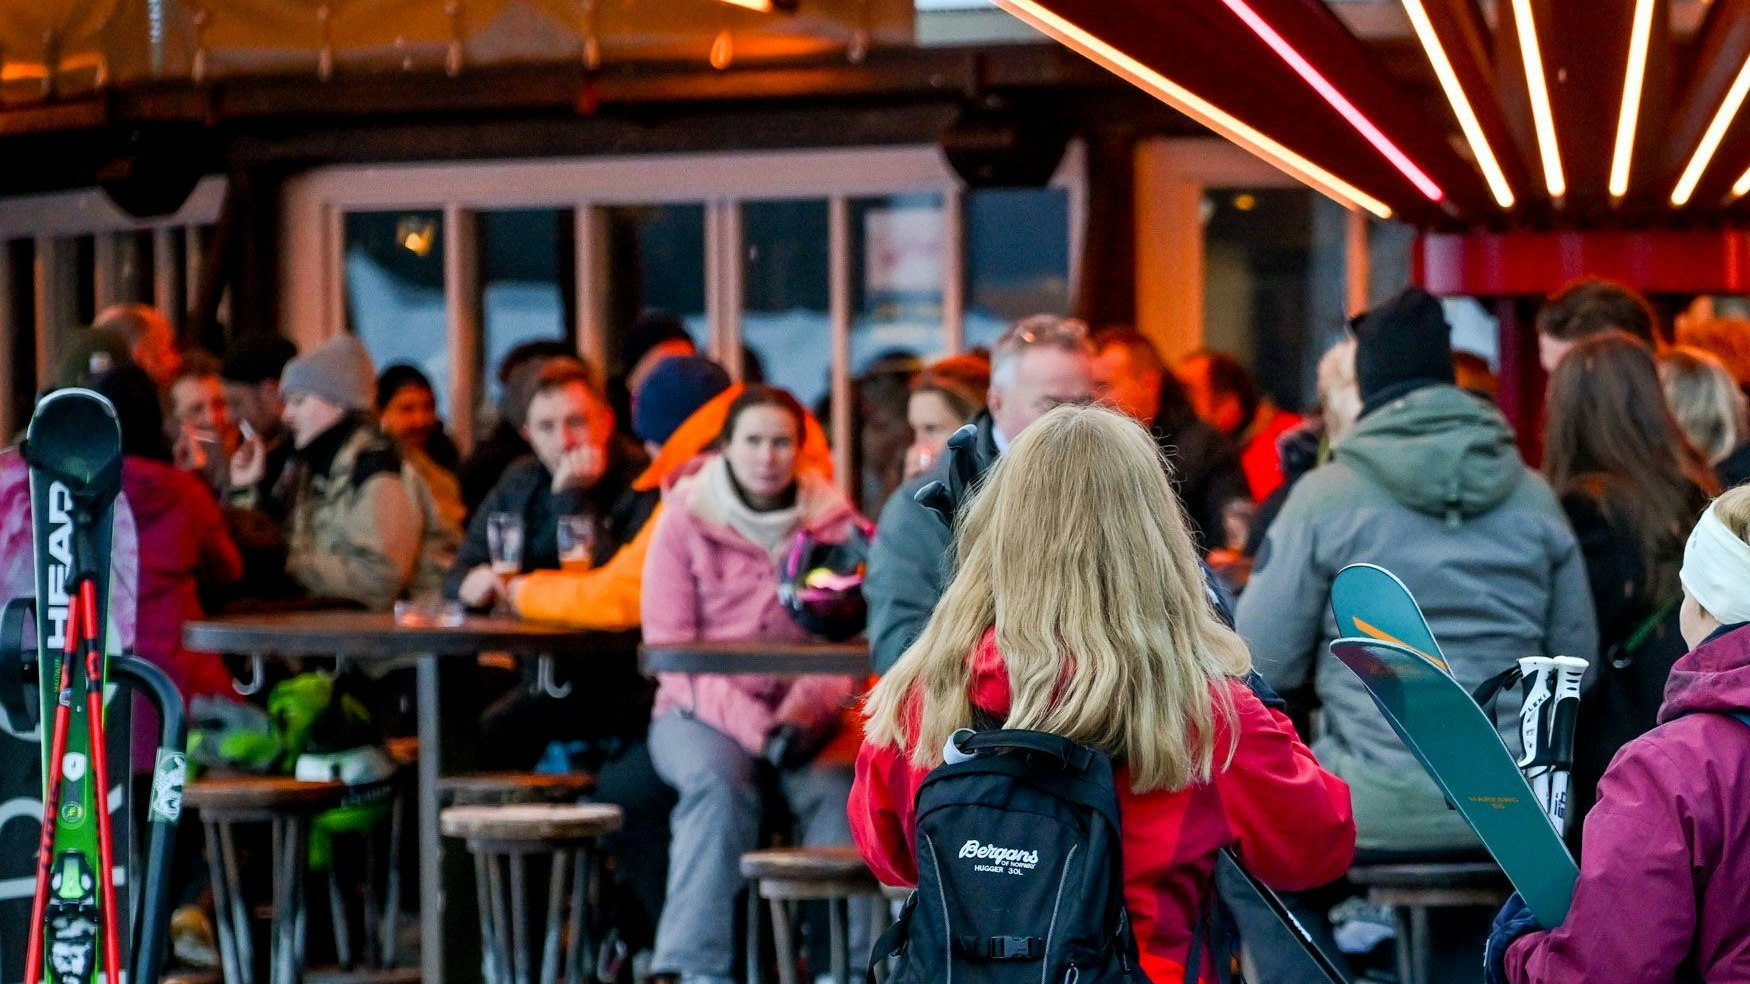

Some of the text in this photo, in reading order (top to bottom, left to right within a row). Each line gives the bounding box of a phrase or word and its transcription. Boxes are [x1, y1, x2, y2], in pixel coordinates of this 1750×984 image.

[958, 839, 1039, 865] Bergans
[974, 864, 1024, 876] HUGGER 30L
